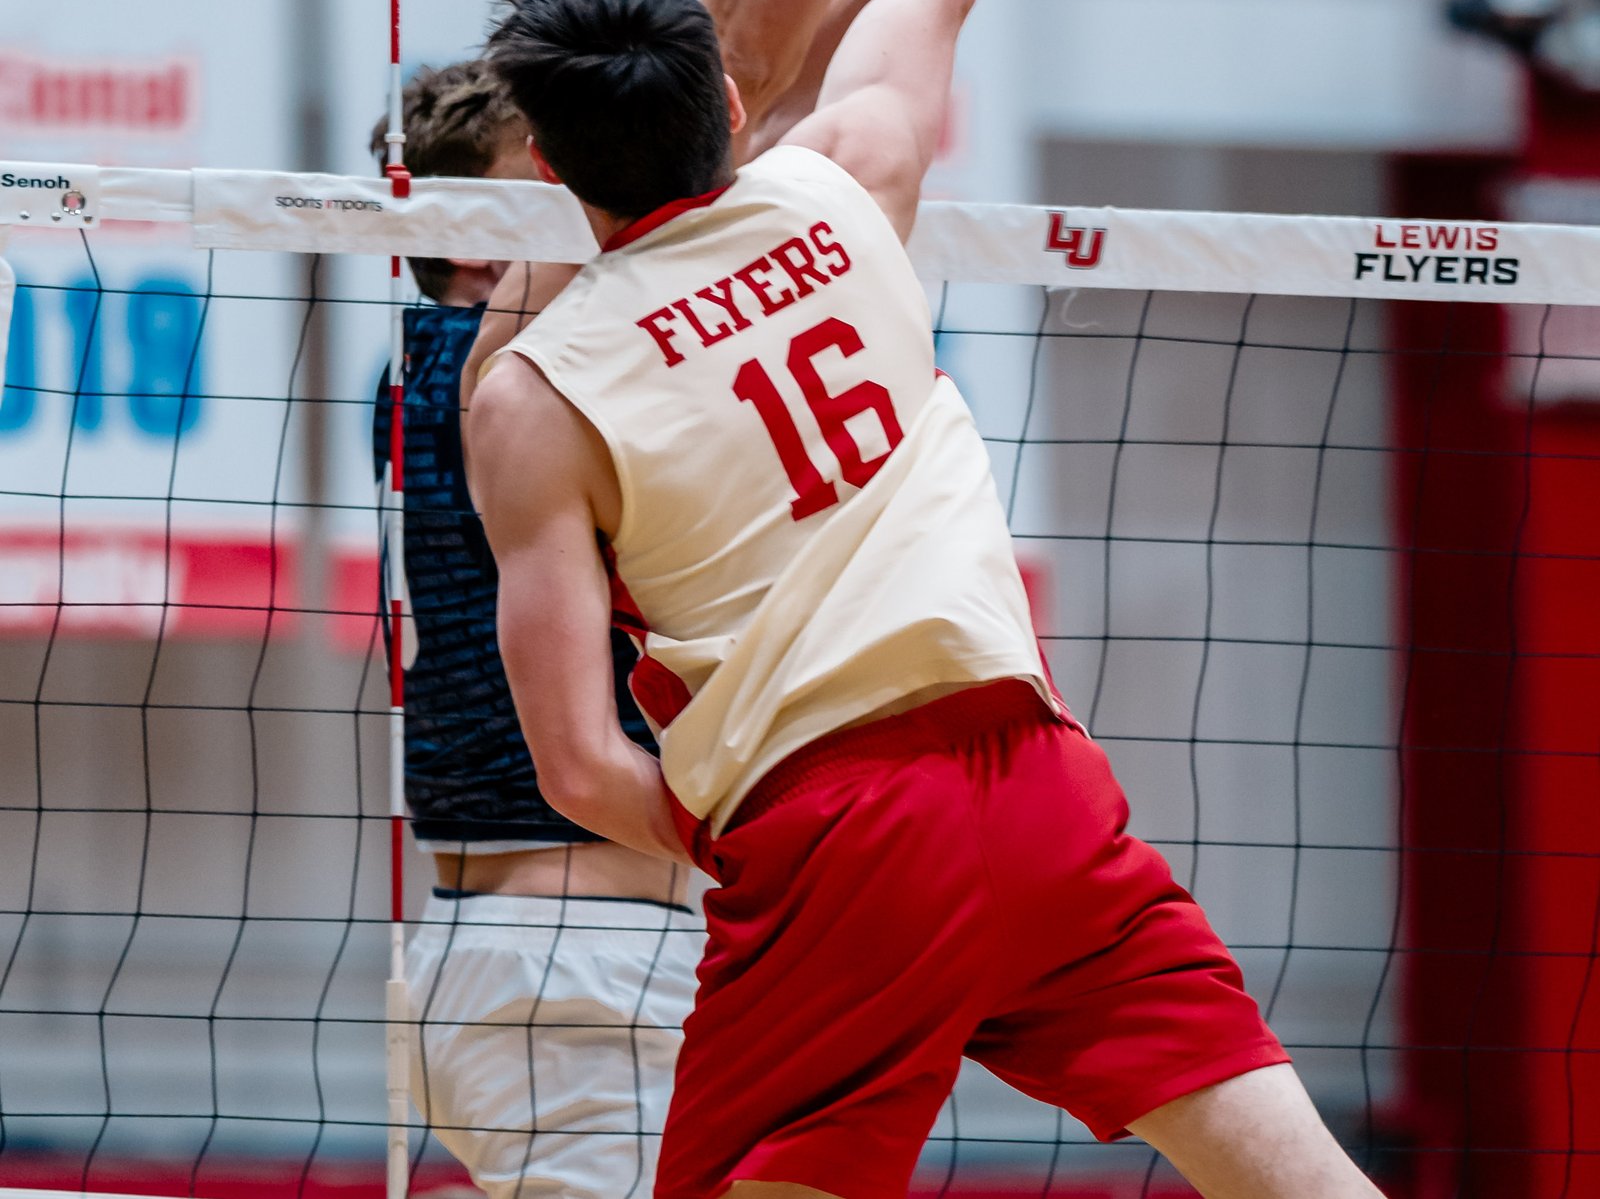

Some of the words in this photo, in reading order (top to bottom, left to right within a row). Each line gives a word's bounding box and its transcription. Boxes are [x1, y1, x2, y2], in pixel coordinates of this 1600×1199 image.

[1, 173, 70, 189] Senoh
[275, 196, 323, 209] sports
[1044, 210, 1107, 269] LU
[1374, 224, 1500, 251] LEWIS
[1354, 252, 1520, 285] FLYERS
[635, 220, 852, 368] FLYERS
[732, 316, 904, 522] 16
